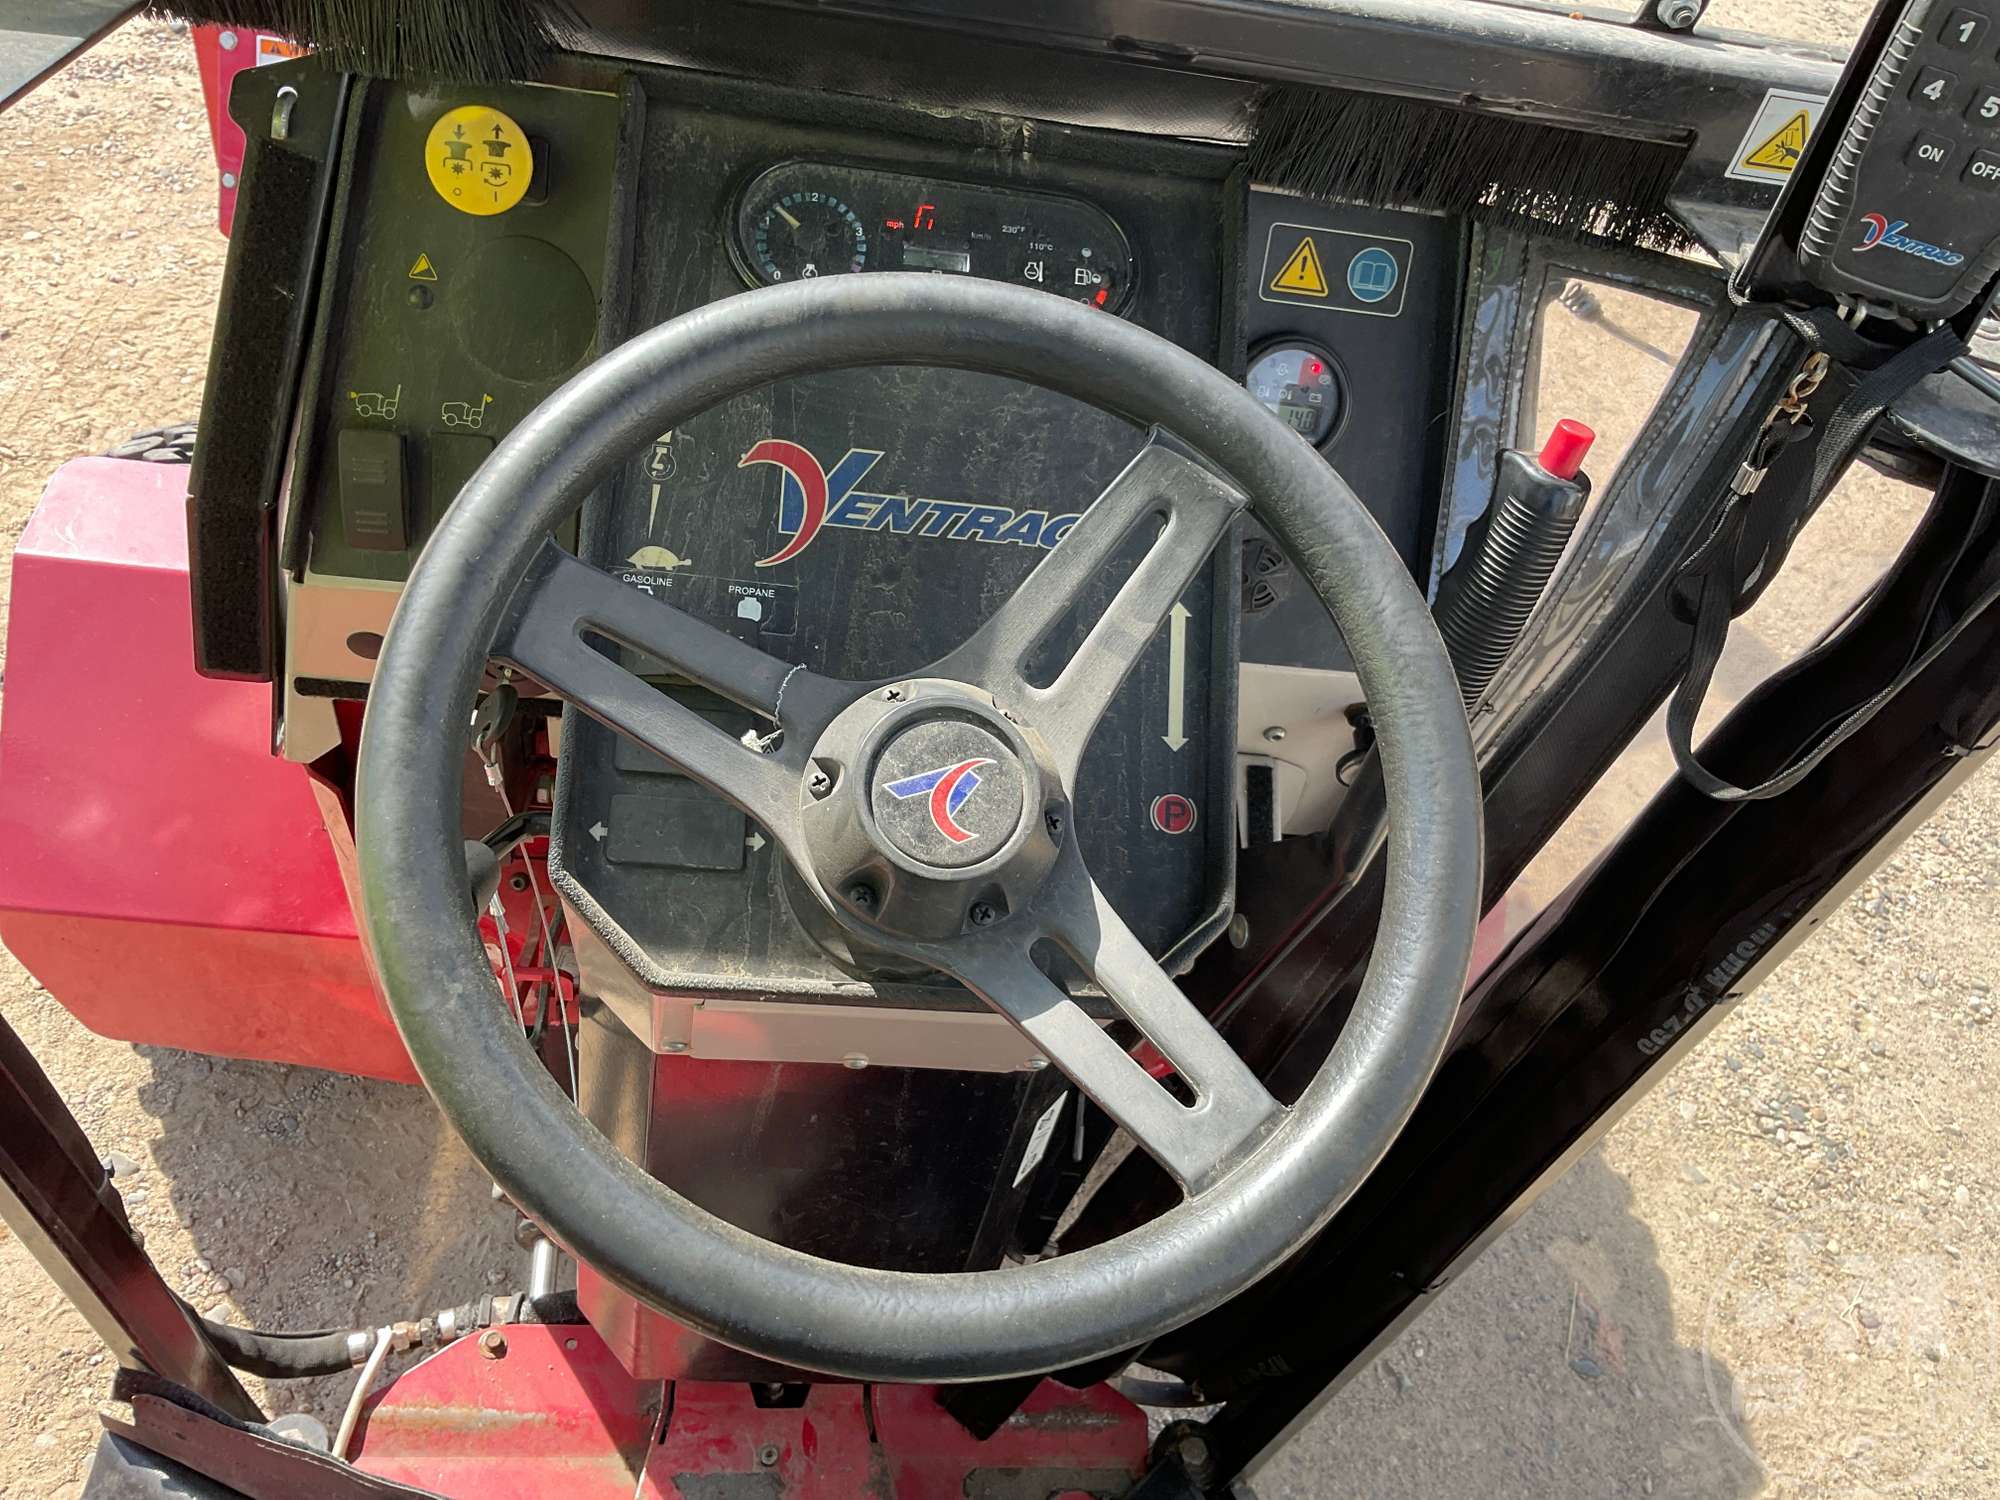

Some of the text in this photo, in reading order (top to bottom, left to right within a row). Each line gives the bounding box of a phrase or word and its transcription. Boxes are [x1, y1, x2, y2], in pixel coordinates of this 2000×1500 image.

[1959, 21, 1976, 42] 1
[1922, 79, 1946, 100] 4
[1980, 95, 2000, 117] 5
[1918, 144, 1944, 162] ON
[622, 573, 673, 587] GASOLINE
[728, 585, 775, 598] PROPANE
[1165, 800, 1186, 828] P
